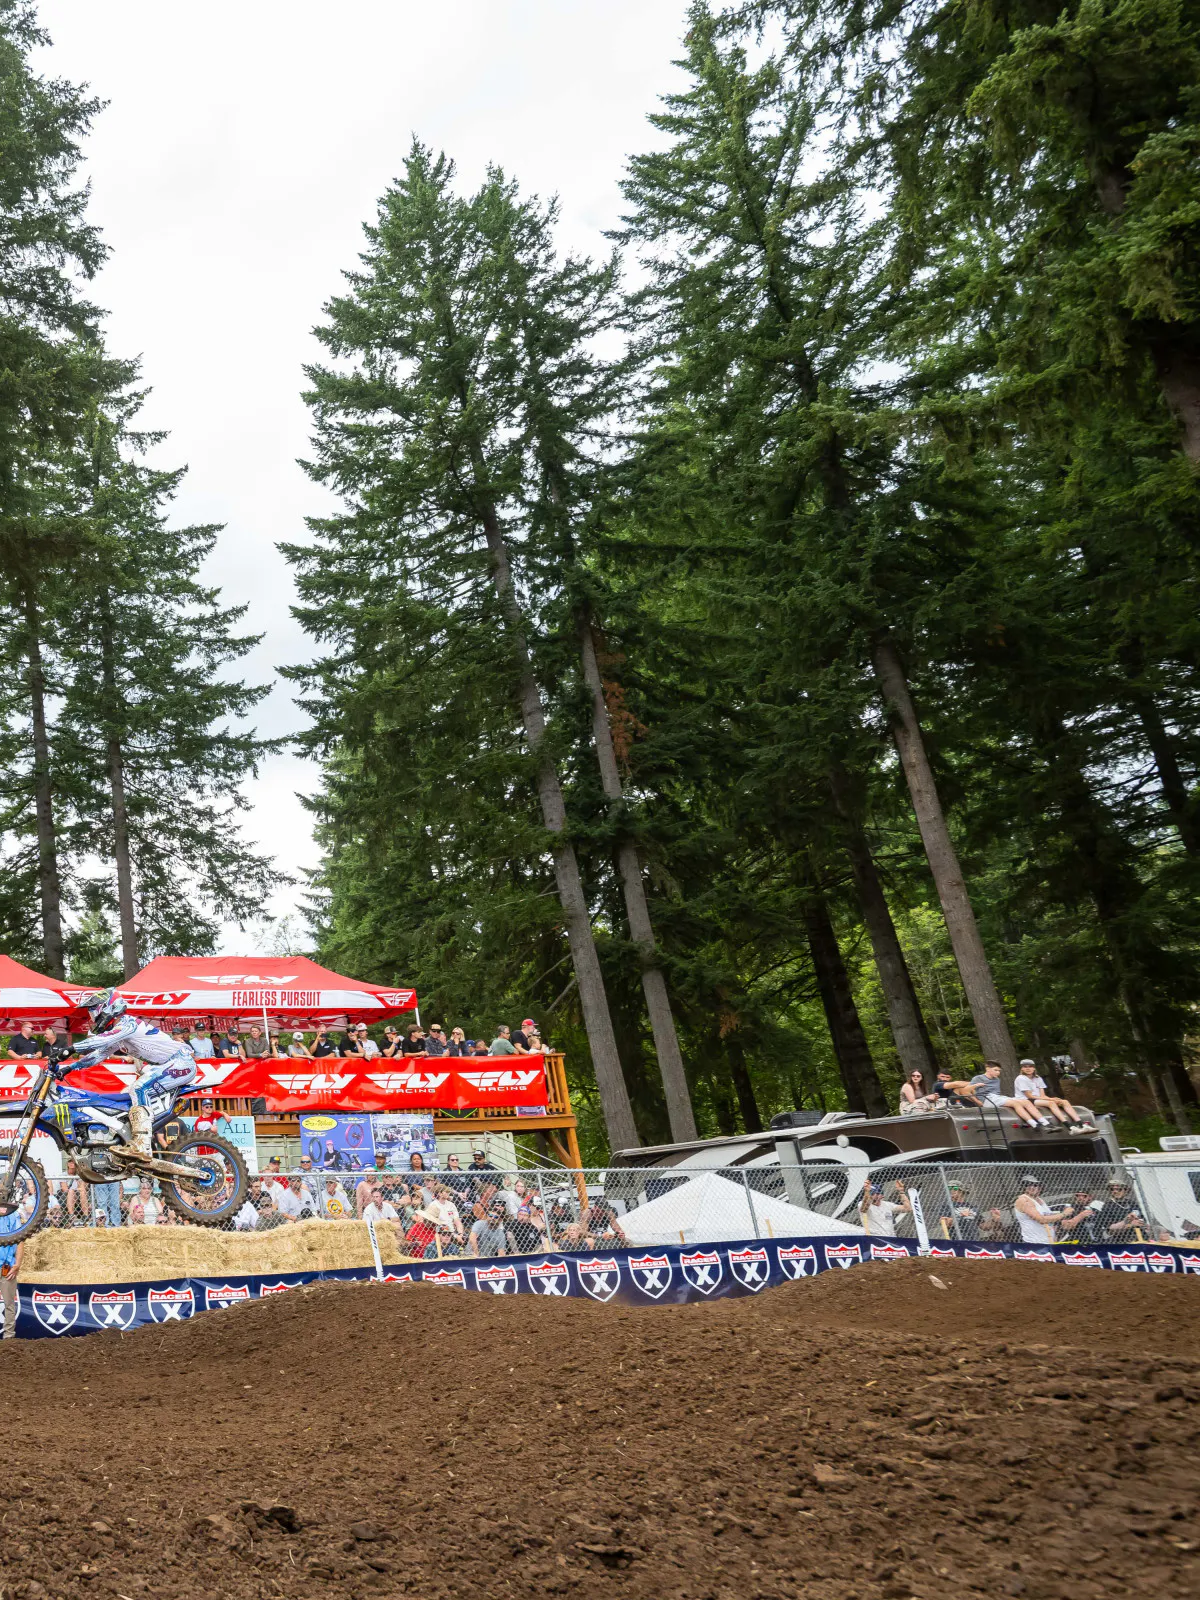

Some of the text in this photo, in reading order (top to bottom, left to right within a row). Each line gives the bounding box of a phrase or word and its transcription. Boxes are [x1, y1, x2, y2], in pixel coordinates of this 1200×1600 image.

[122, 992, 191, 1005] FLY
[232, 990, 321, 1007] FEARLESS PURSUIT
[268, 1073, 358, 1090] FLY
[364, 1073, 451, 1089] FLY
[457, 1070, 541, 1087] FLY
[223, 1122, 251, 1134] ALL
[683, 1255, 720, 1264] RACER
[732, 1253, 766, 1261] RACER
[781, 1250, 813, 1258] RACER
[530, 1267, 566, 1275] RACER
[580, 1263, 617, 1271] RACER
[631, 1260, 669, 1269] RACER
[789, 1259, 811, 1279] X
[478, 1270, 514, 1279] RACER
[641, 1268, 665, 1290] X
[692, 1265, 715, 1286] X
[741, 1262, 763, 1282] X
[542, 1276, 562, 1296] X
[589, 1272, 612, 1293] X
[36, 1294, 76, 1302] RACER
[93, 1294, 133, 1302] RACER
[151, 1292, 190, 1300] RACER
[209, 1290, 248, 1298] RACER
[45, 1304, 69, 1324] X
[102, 1303, 126, 1324] X
[161, 1303, 183, 1321] X
